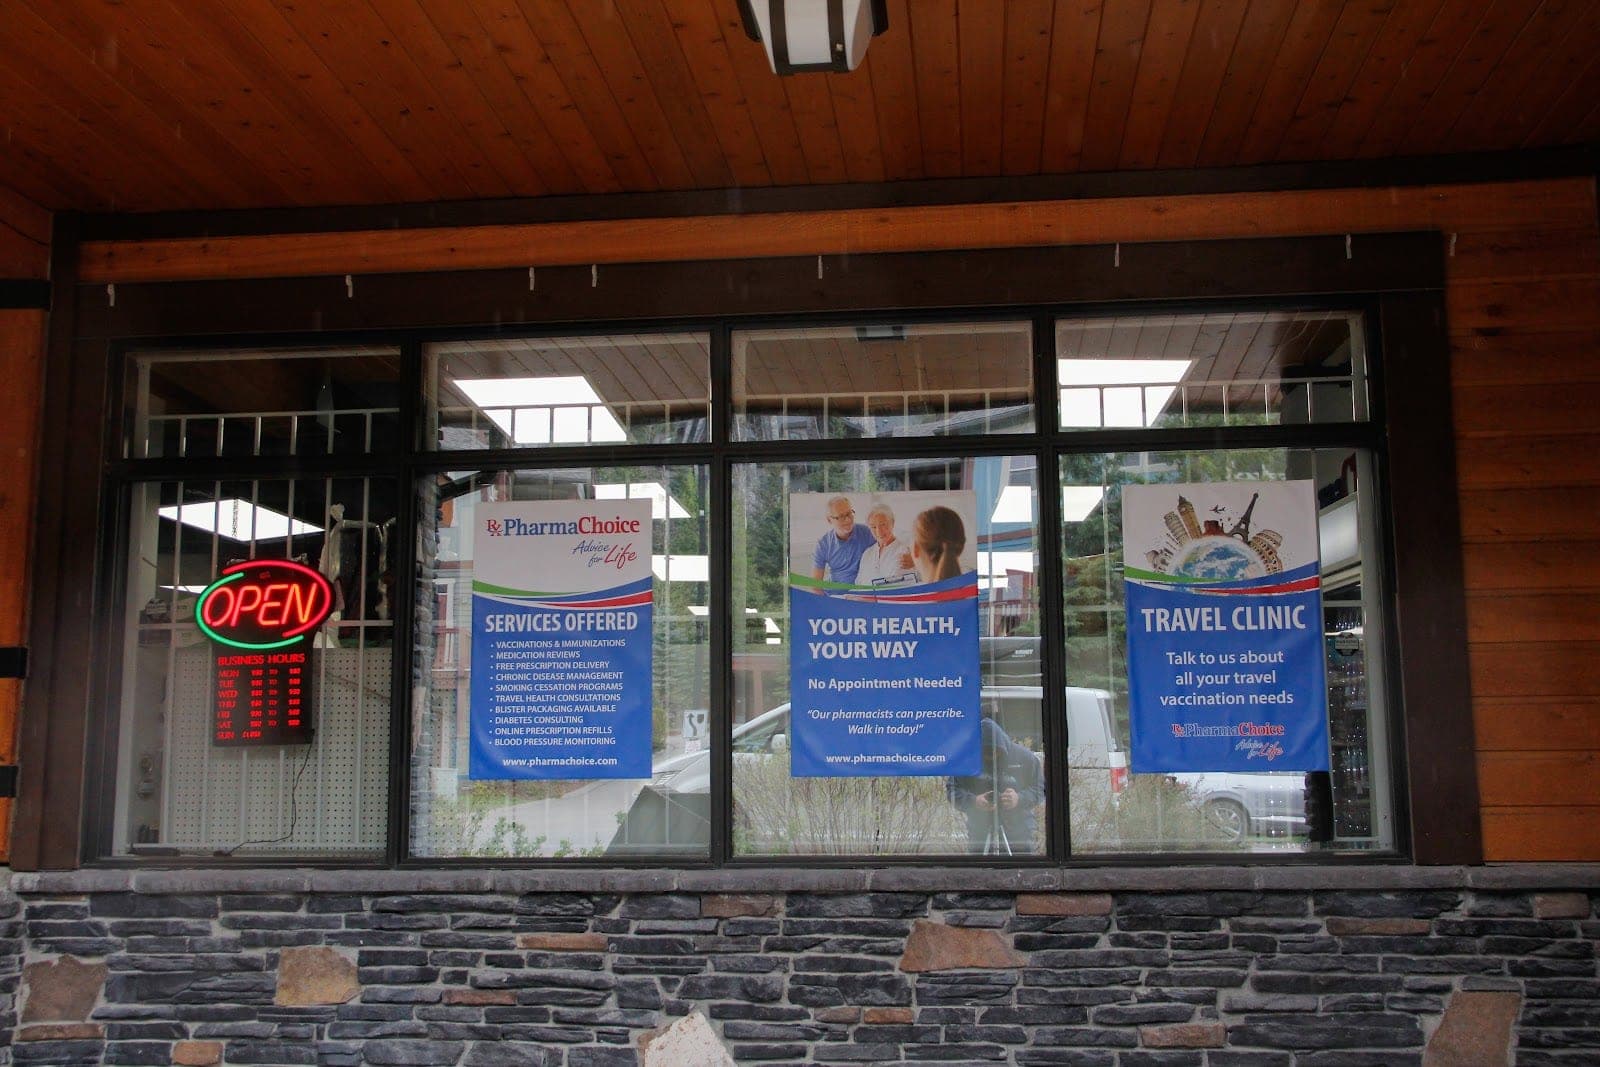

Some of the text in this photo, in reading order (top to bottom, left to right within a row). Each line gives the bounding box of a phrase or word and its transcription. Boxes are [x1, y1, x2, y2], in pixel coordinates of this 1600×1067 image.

[572, 540, 610, 554] Advice
[588, 543, 638, 569] for Life
[203, 583, 318, 627] OPEN
[486, 612, 638, 632] SERVICES OFFERED
[1141, 605, 1306, 632] TRAVEL CLINIC
[808, 616, 961, 636] YOUR HEALTH,
[496, 640, 552, 649] VACCINATIONS
[562, 640, 626, 648] IMMUNIZATIONS
[808, 641, 918, 660] YOUR WAY
[218, 653, 305, 666] BUSINESS HOURS
[496, 652, 545, 660] MEDICATION
[1166, 650, 1284, 665] Talk to us about
[572, 661, 609, 669] DELIVERY
[532, 672, 565, 680] DISEASE
[566, 672, 624, 680] MANAGEMENT
[1176, 670, 1276, 688] all your travel
[578, 682, 624, 690] PROGRAMS
[808, 676, 962, 692] No Appointment Needed
[558, 694, 621, 702] CONSULTATIONS
[1160, 690, 1294, 706] vaccination needs
[527, 705, 573, 713] PACKAGING
[574, 704, 616, 712] AVAILABLE
[832, 708, 894, 722] pharmacists
[896, 710, 914, 718] can
[915, 708, 964, 720] prescribe.
[848, 724, 872, 734] Walk
[874, 724, 884, 734] in
[503, 756, 618, 768] www.pharmachoice.com
[826, 754, 946, 764] www.pharmachoice.com
